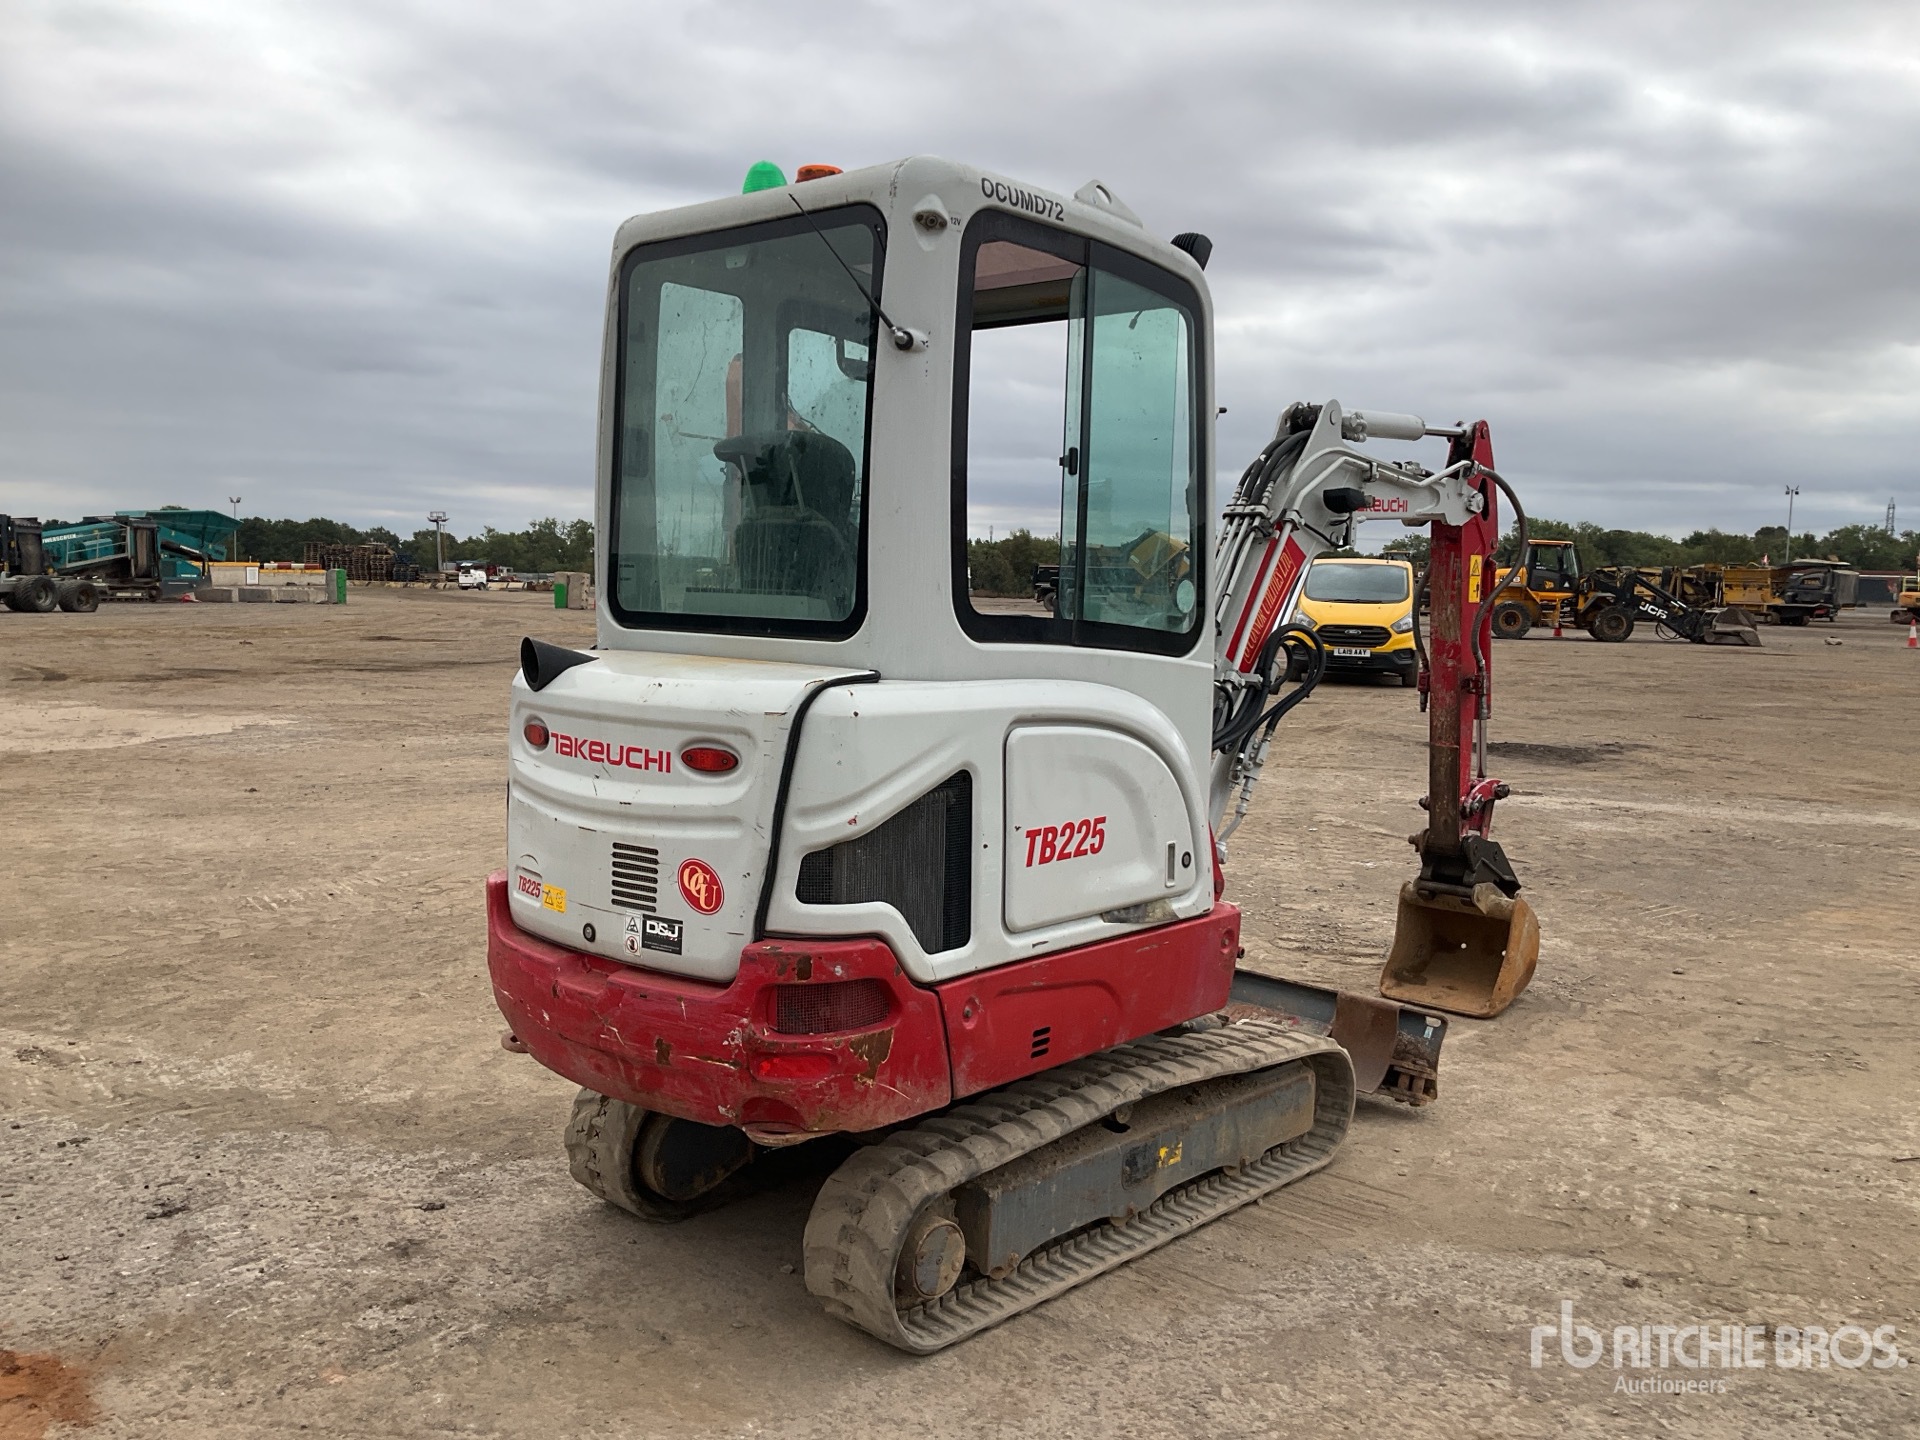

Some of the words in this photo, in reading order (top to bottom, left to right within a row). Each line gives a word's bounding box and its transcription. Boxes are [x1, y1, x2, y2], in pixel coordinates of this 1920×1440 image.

[981, 177, 1064, 222] OCUMD72
[950, 216, 961, 226] 12V
[1639, 603, 1668, 619] JCB
[1025, 816, 1107, 868] TB225
[518, 874, 542, 898] TB225
[646, 920, 679, 938] D&J
